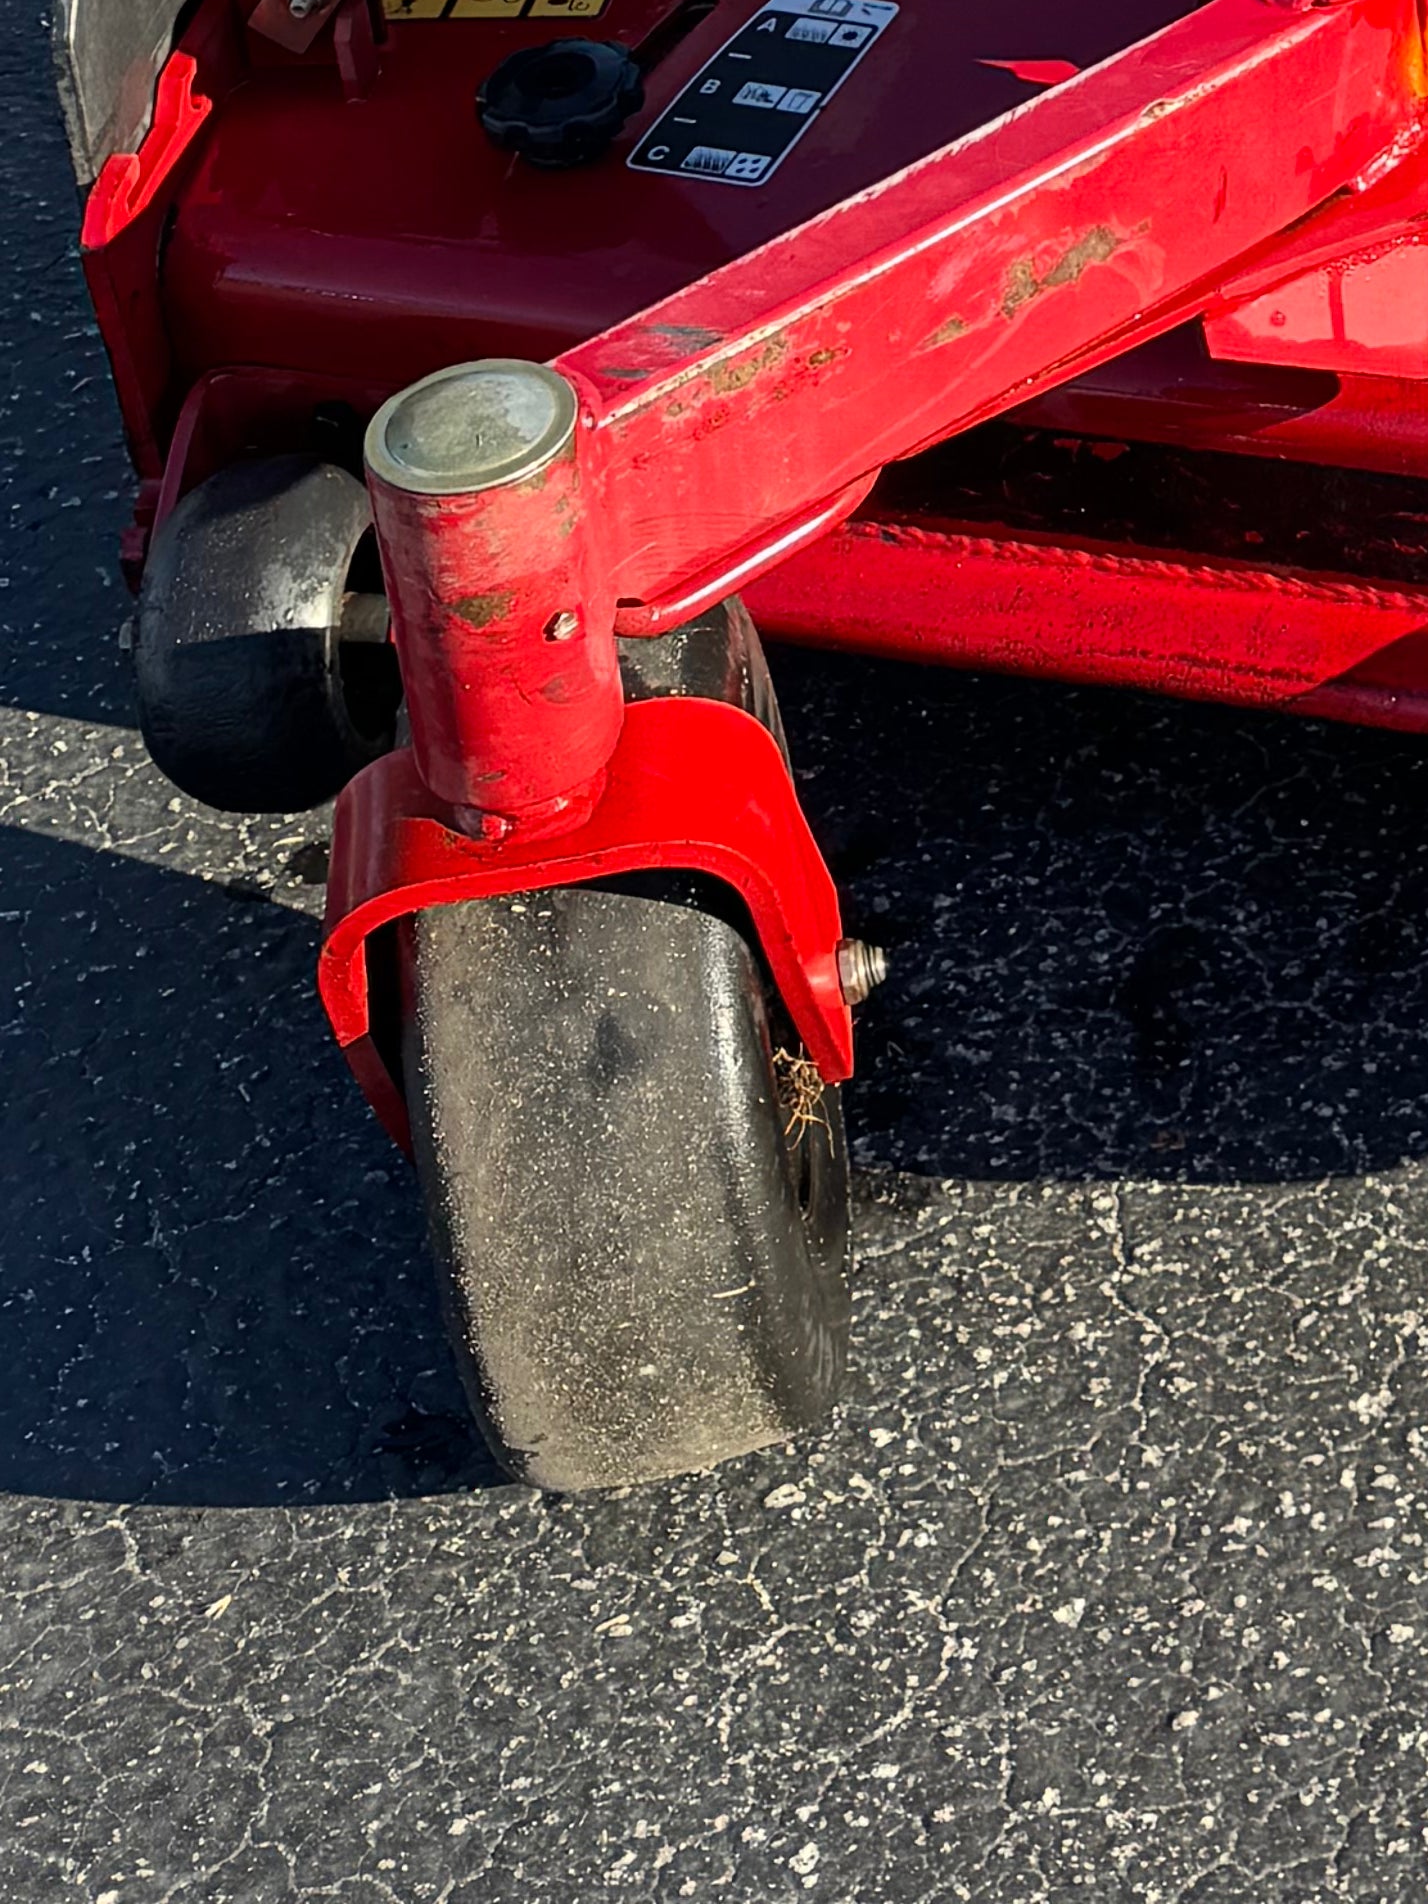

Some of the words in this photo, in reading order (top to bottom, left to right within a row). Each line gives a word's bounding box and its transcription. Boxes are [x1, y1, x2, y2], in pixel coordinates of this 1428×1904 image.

[756, 16, 778, 34] A
[699, 78, 721, 94] B
[647, 145, 670, 161] C
